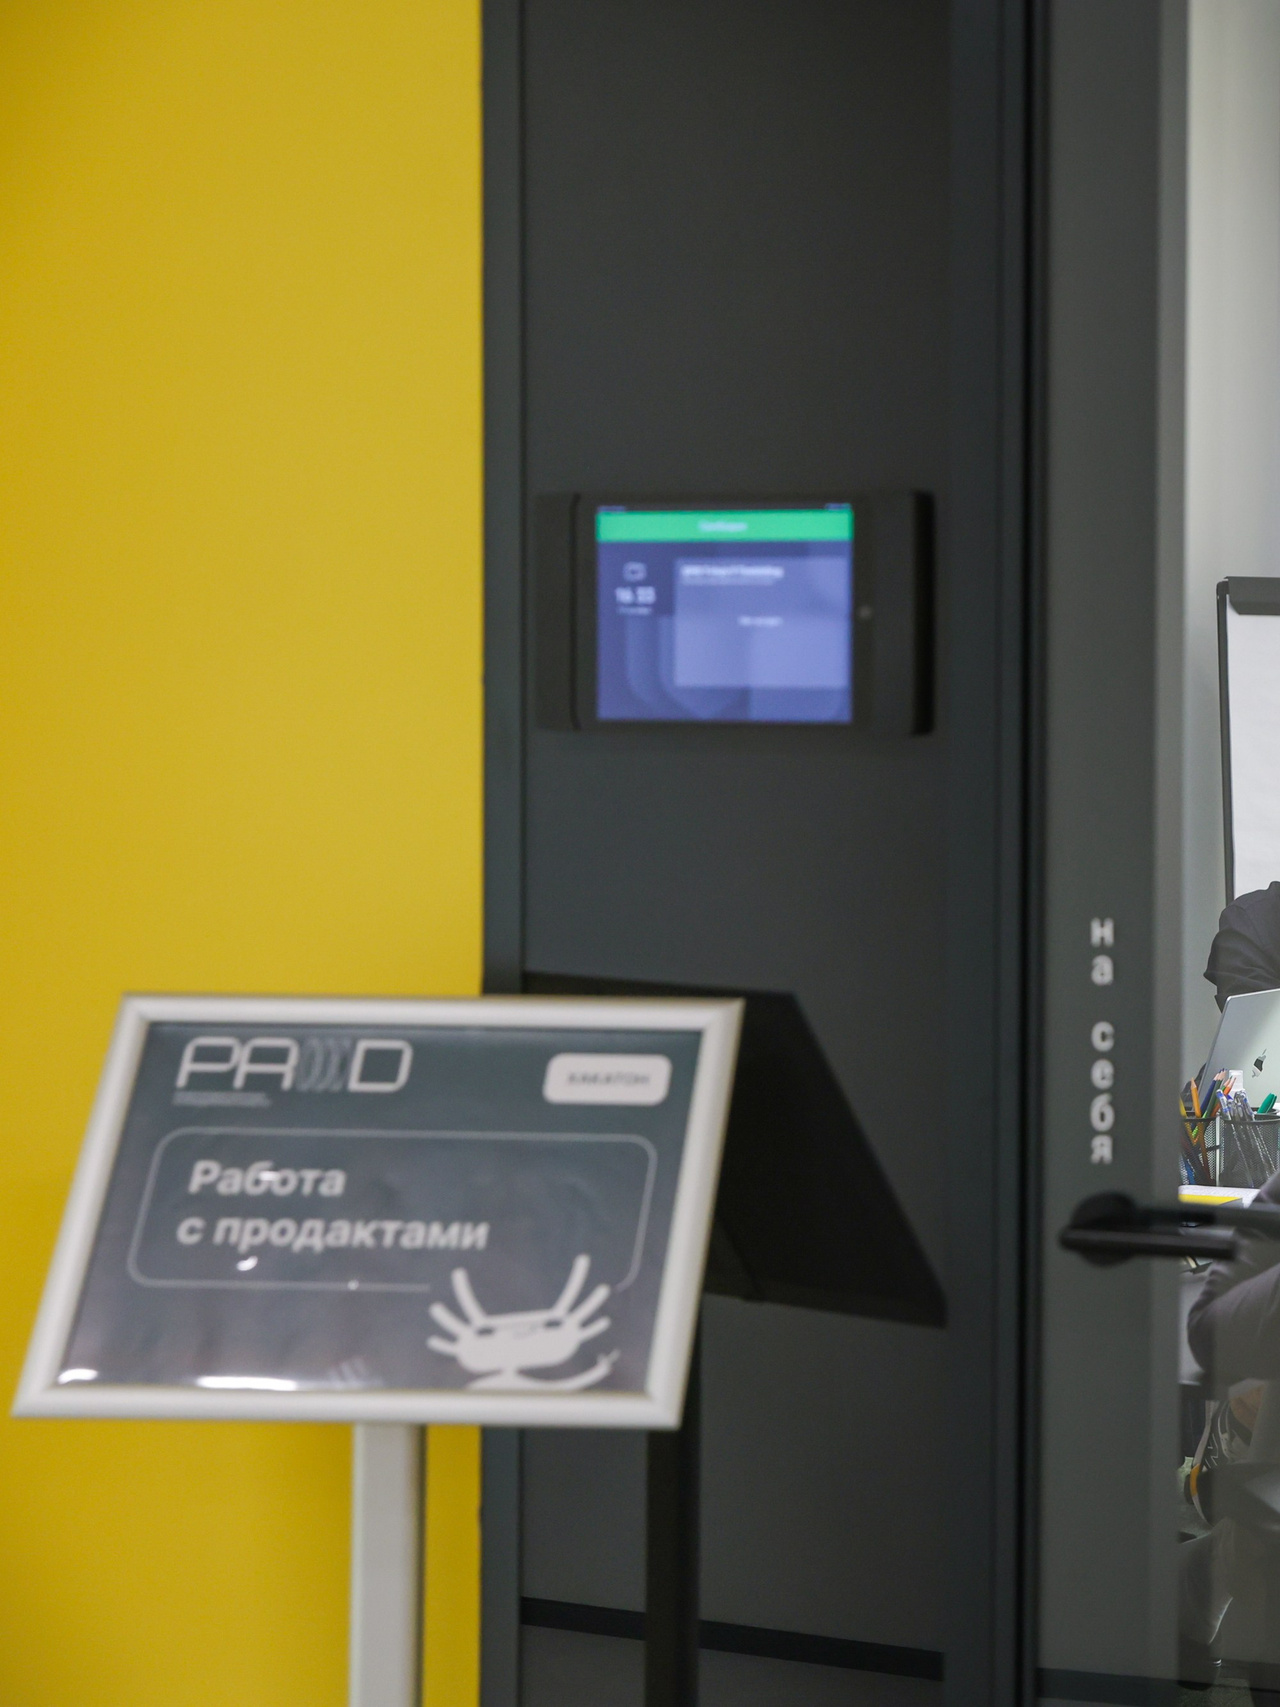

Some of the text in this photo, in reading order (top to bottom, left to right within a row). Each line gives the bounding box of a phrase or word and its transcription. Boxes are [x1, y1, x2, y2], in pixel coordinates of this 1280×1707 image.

[1089, 917, 1115, 1164] на себя
[188, 1159, 346, 1196] Работа
[176, 1216, 490, 1254] с продактами
